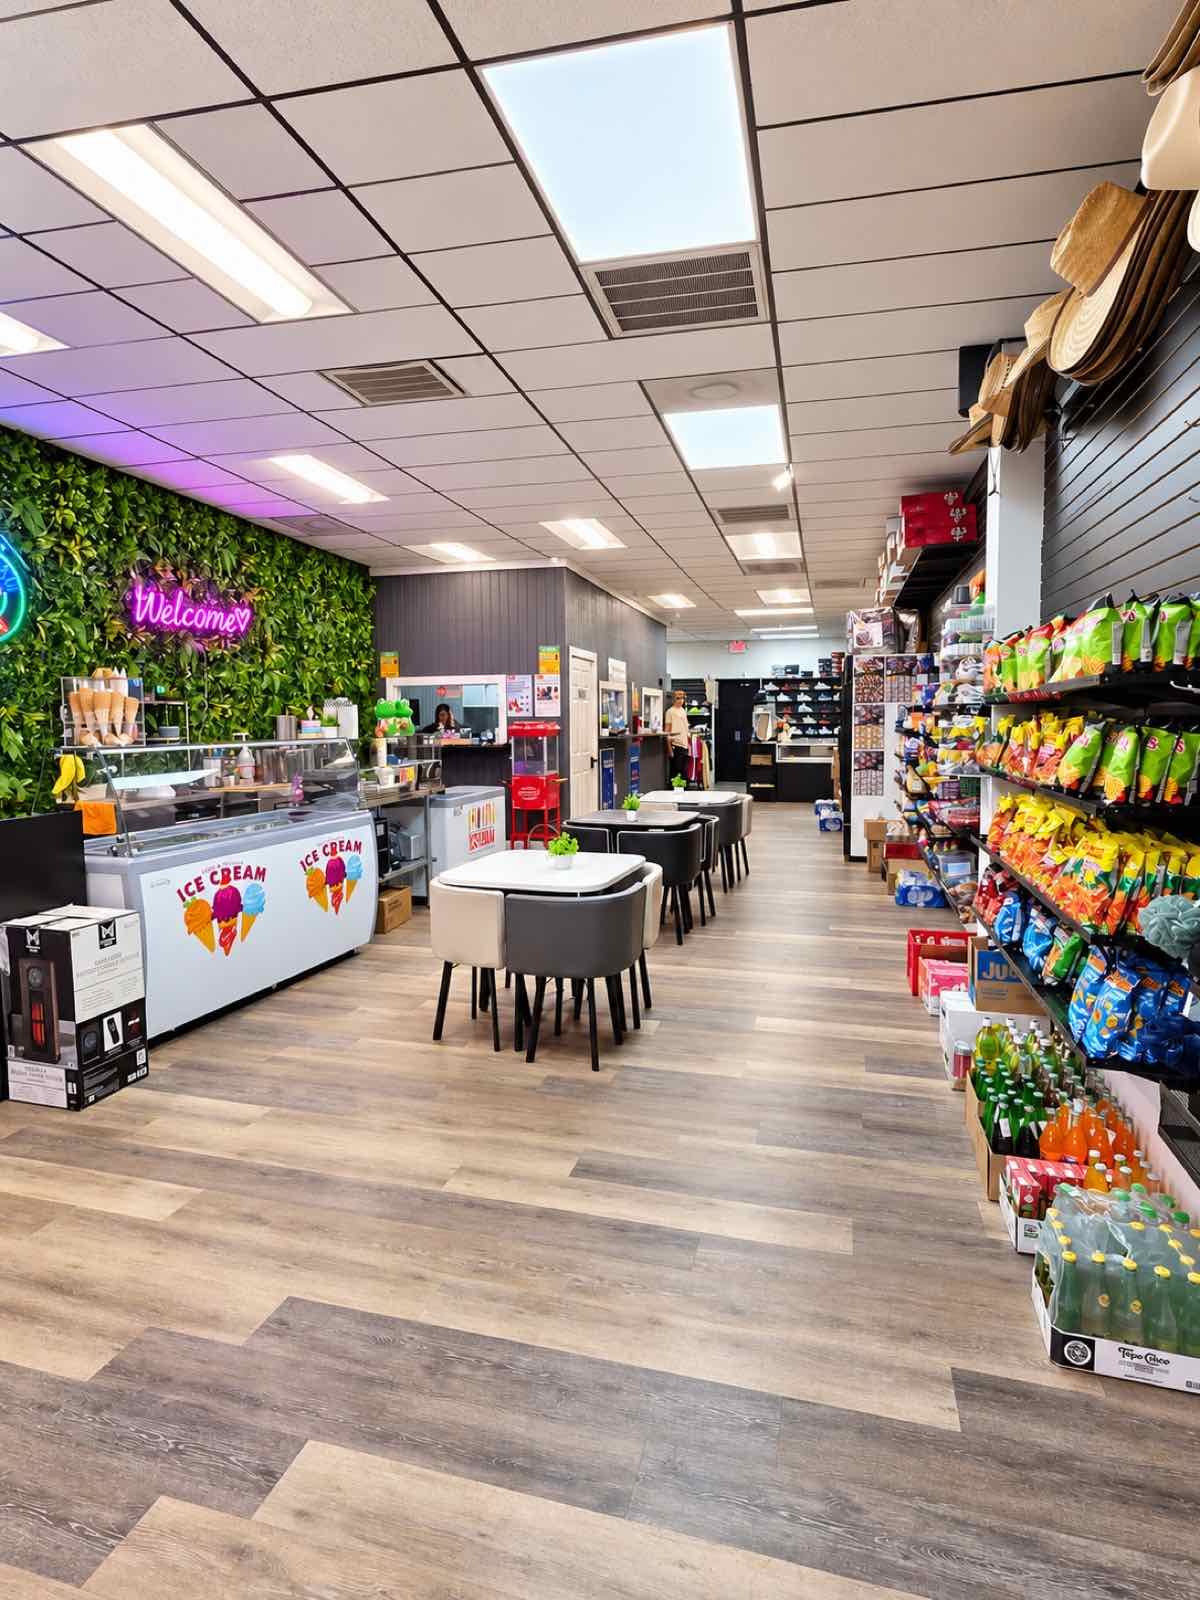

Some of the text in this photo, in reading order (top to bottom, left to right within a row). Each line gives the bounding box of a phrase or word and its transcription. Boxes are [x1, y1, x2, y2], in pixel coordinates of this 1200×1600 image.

[135, 584, 237, 632] Welcome
[300, 839, 362, 872] ICE CREAM
[176, 876, 205, 902] ICE
[210, 865, 266, 885] CREAM
